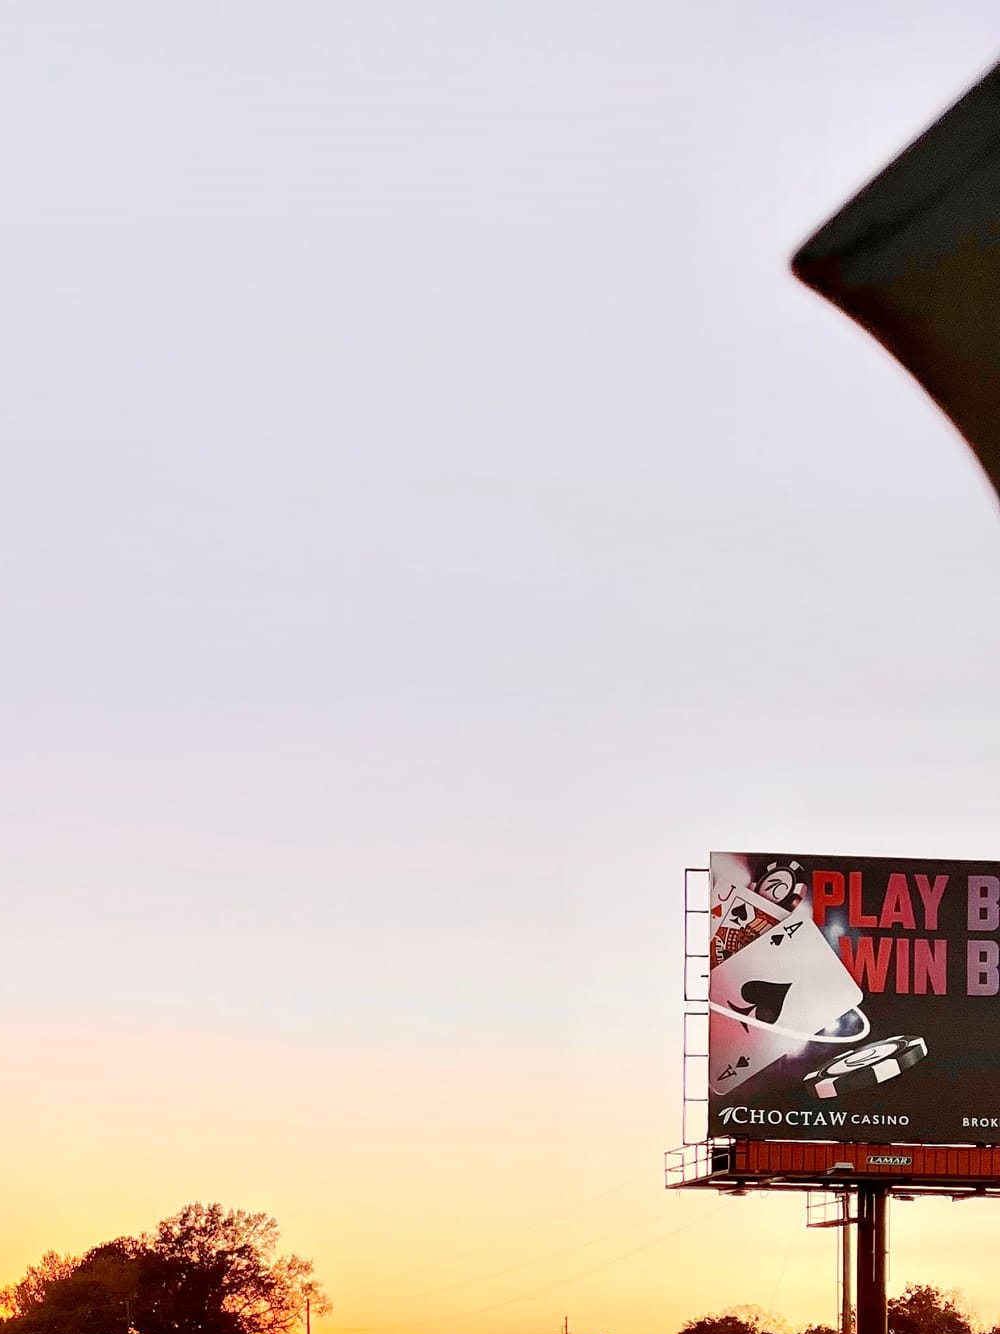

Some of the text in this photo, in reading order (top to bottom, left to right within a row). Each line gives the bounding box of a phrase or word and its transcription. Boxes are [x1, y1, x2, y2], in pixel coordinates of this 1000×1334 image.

[718, 884, 737, 902] J
[813, 870, 949, 930] PLAY
[783, 920, 804, 939] A
[838, 936, 948, 995] WIN
[717, 1064, 738, 1082] A
[731, 1106, 848, 1126] CHOCTAW
[851, 1113, 910, 1126] CASINO
[869, 1156, 909, 1164] LAMAR
